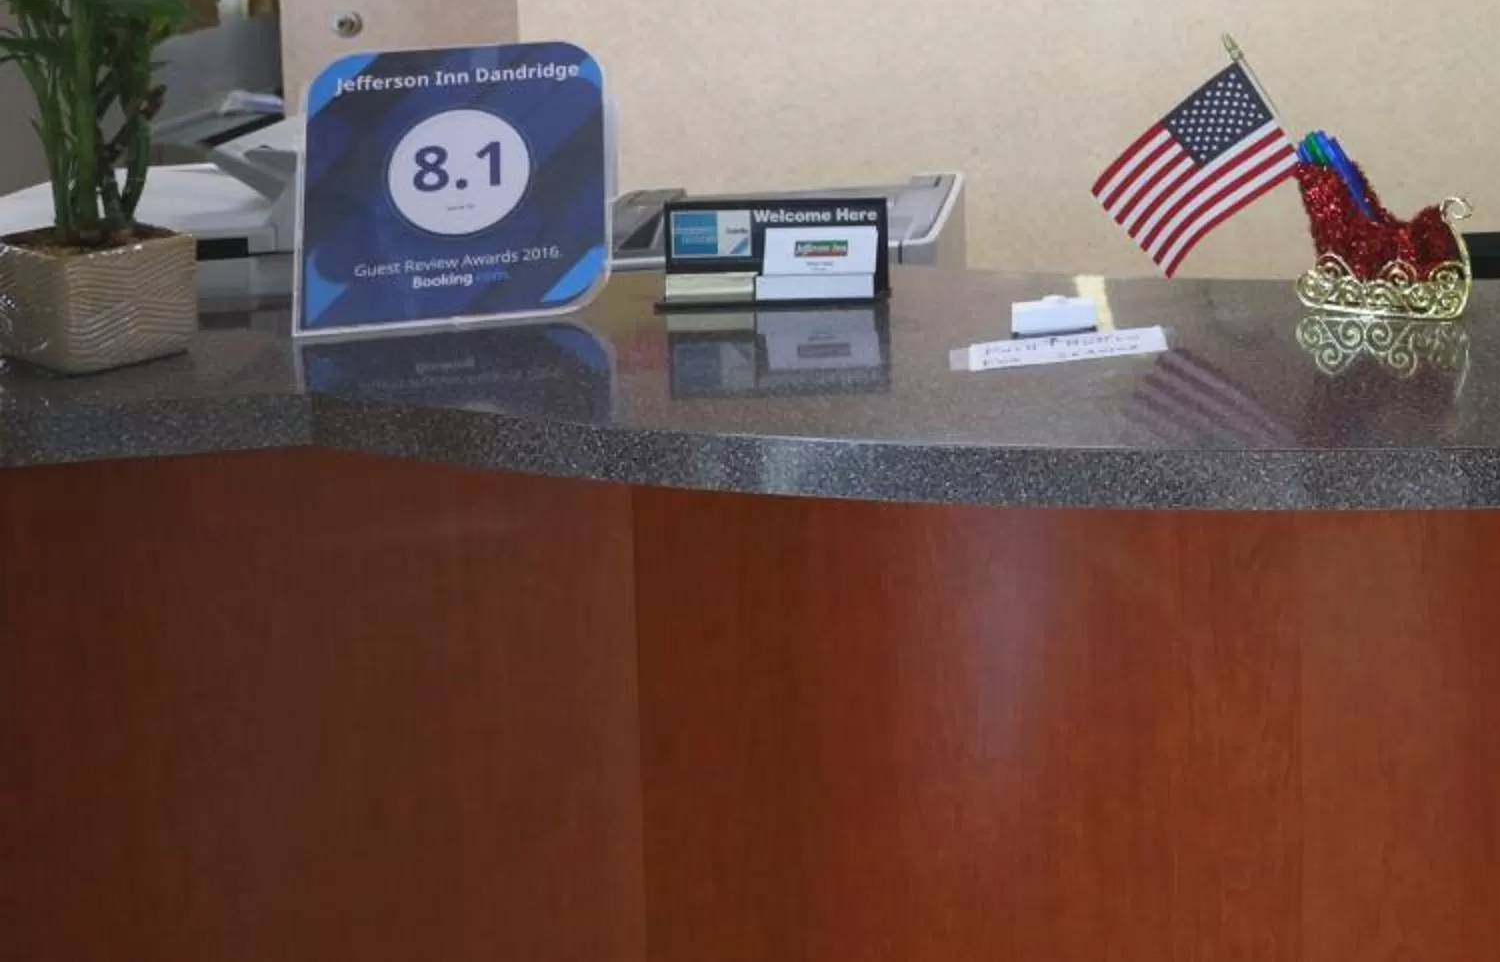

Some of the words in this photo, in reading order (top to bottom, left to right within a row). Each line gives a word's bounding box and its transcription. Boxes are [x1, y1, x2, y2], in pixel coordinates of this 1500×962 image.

[335, 73, 429, 96] Jefferson
[435, 70, 469, 86] Inn
[475, 62, 580, 84] Dandridge
[413, 141, 502, 192] 8.1
[752, 208, 832, 224] Welcome
[836, 207, 879, 222] Here
[354, 261, 400, 278] Guest
[404, 257, 459, 273] Review
[463, 248, 519, 268] Awards
